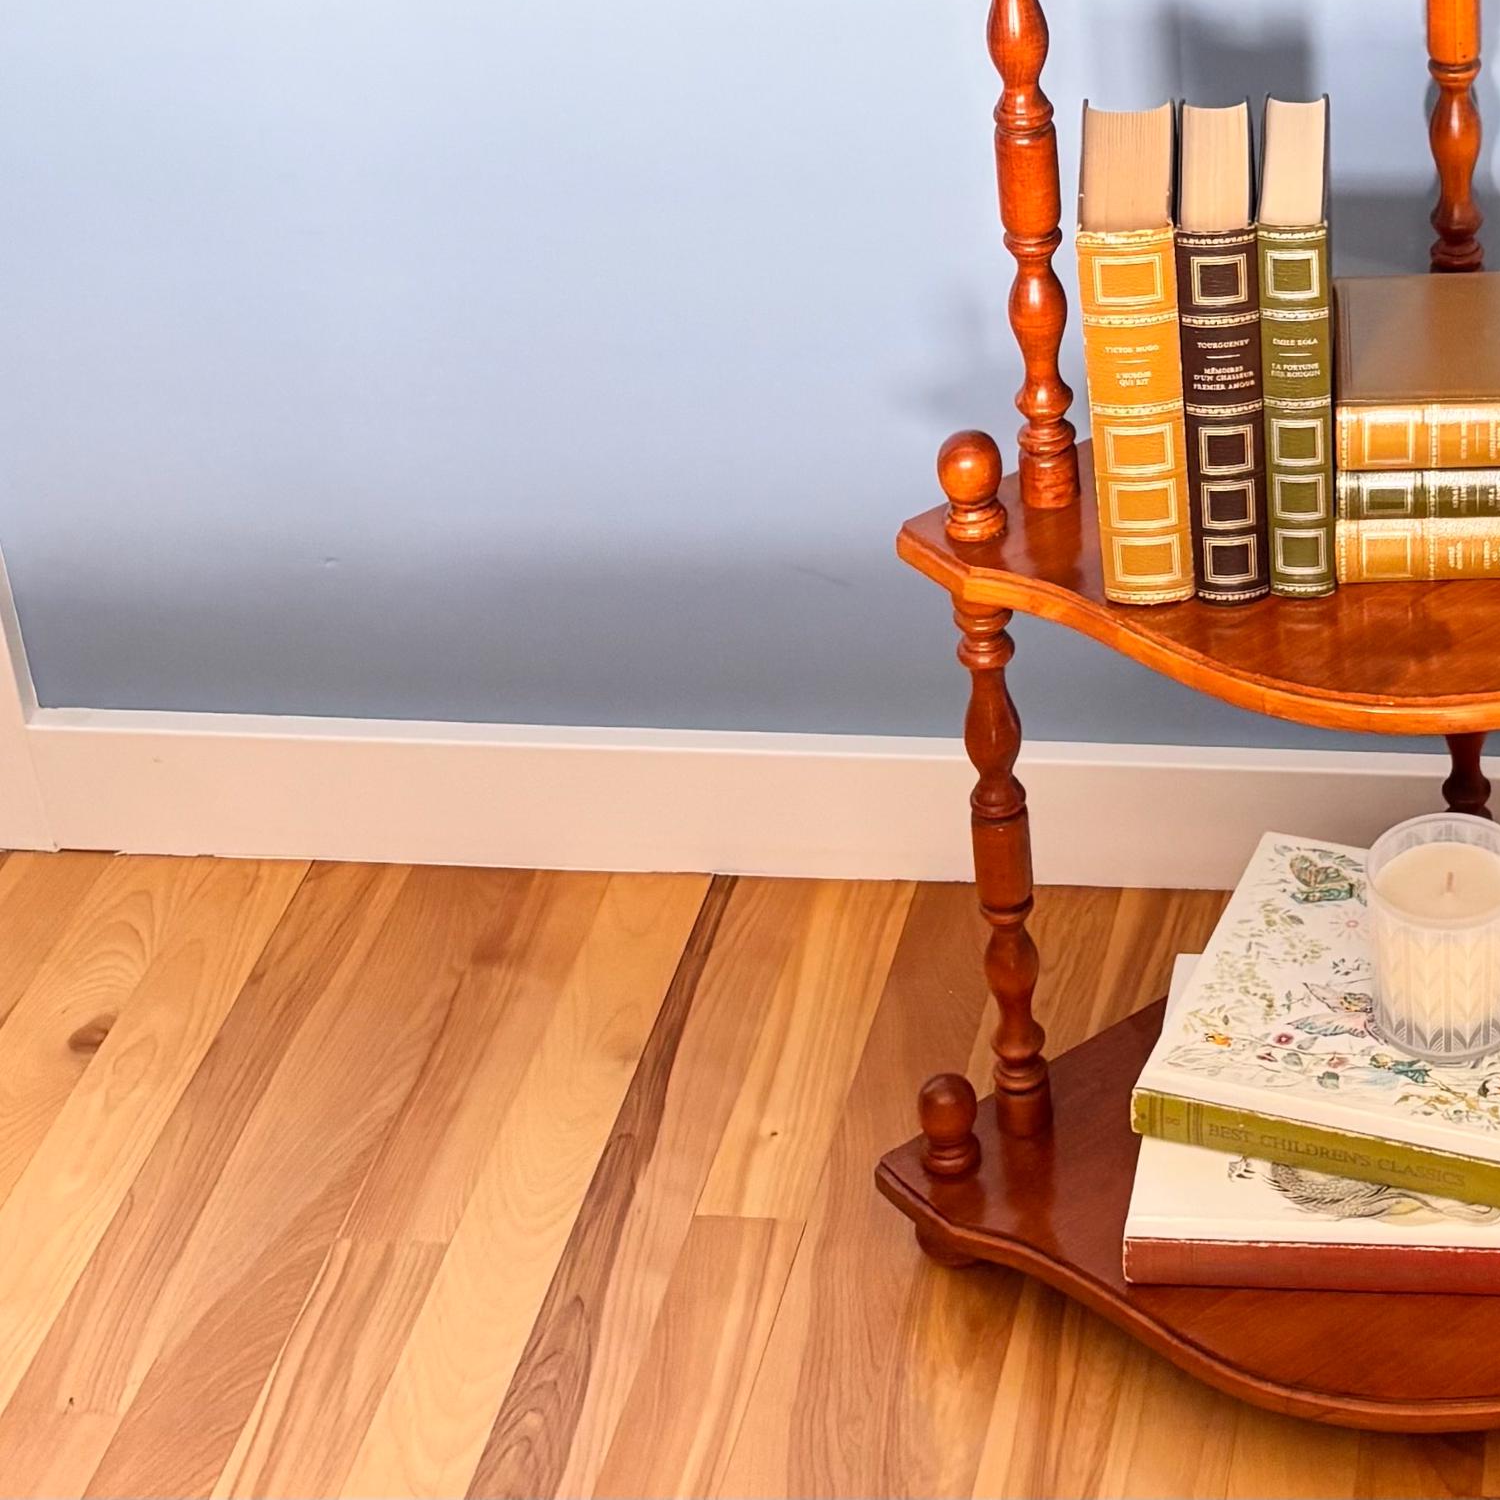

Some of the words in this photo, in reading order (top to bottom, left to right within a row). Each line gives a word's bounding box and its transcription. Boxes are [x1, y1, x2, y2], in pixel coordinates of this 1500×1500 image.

[1271, 362, 1282, 370] LA
[1283, 362, 1320, 371] FORTUNE
[1193, 374, 1214, 382] D'UN
[1215, 371, 1254, 382] CHASSEUR
[1193, 383, 1226, 391] PREMIER
[1227, 379, 1256, 390] AMOUR
[1208, 1123, 1250, 1143] BEST
[1377, 1158, 1466, 1187] CLASSICS
